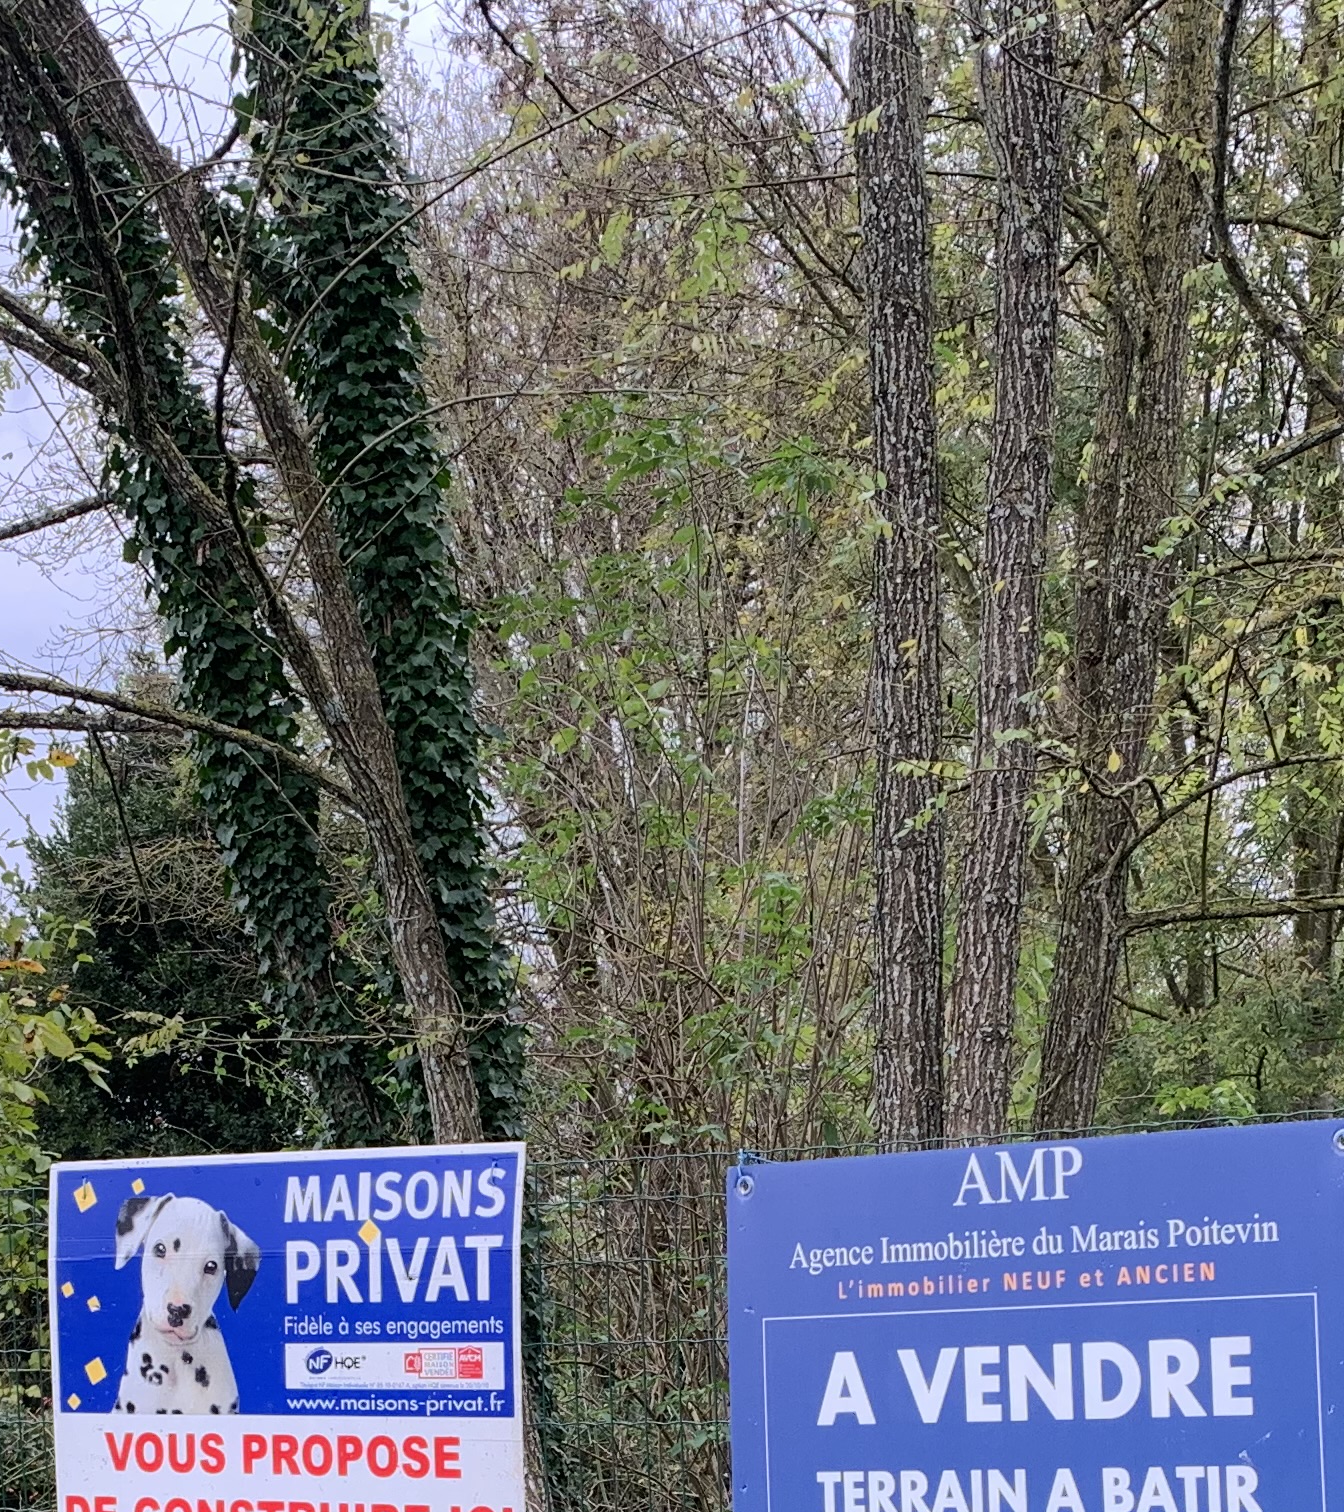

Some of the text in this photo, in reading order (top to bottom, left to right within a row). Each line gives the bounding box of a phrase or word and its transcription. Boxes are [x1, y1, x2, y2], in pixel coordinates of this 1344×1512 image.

[284, 1167, 506, 1224] MAISONS
[952, 1144, 1084, 1208] AMP
[284, 1234, 504, 1305] PRIVAT
[788, 1212, 1280, 1275] Agence Immobilière du Marais Poitevin
[837, 1262, 1216, 1300] L'immobilier NEUF et ANCIEN
[284, 1316, 504, 1340] Fidèle à ses engagements
[286, 1392, 506, 1416] www.maisons-privat.fr
[816, 1336, 1255, 1427] A VENDRE
[104, 1432, 462, 1479] VOUS PROPOSE
